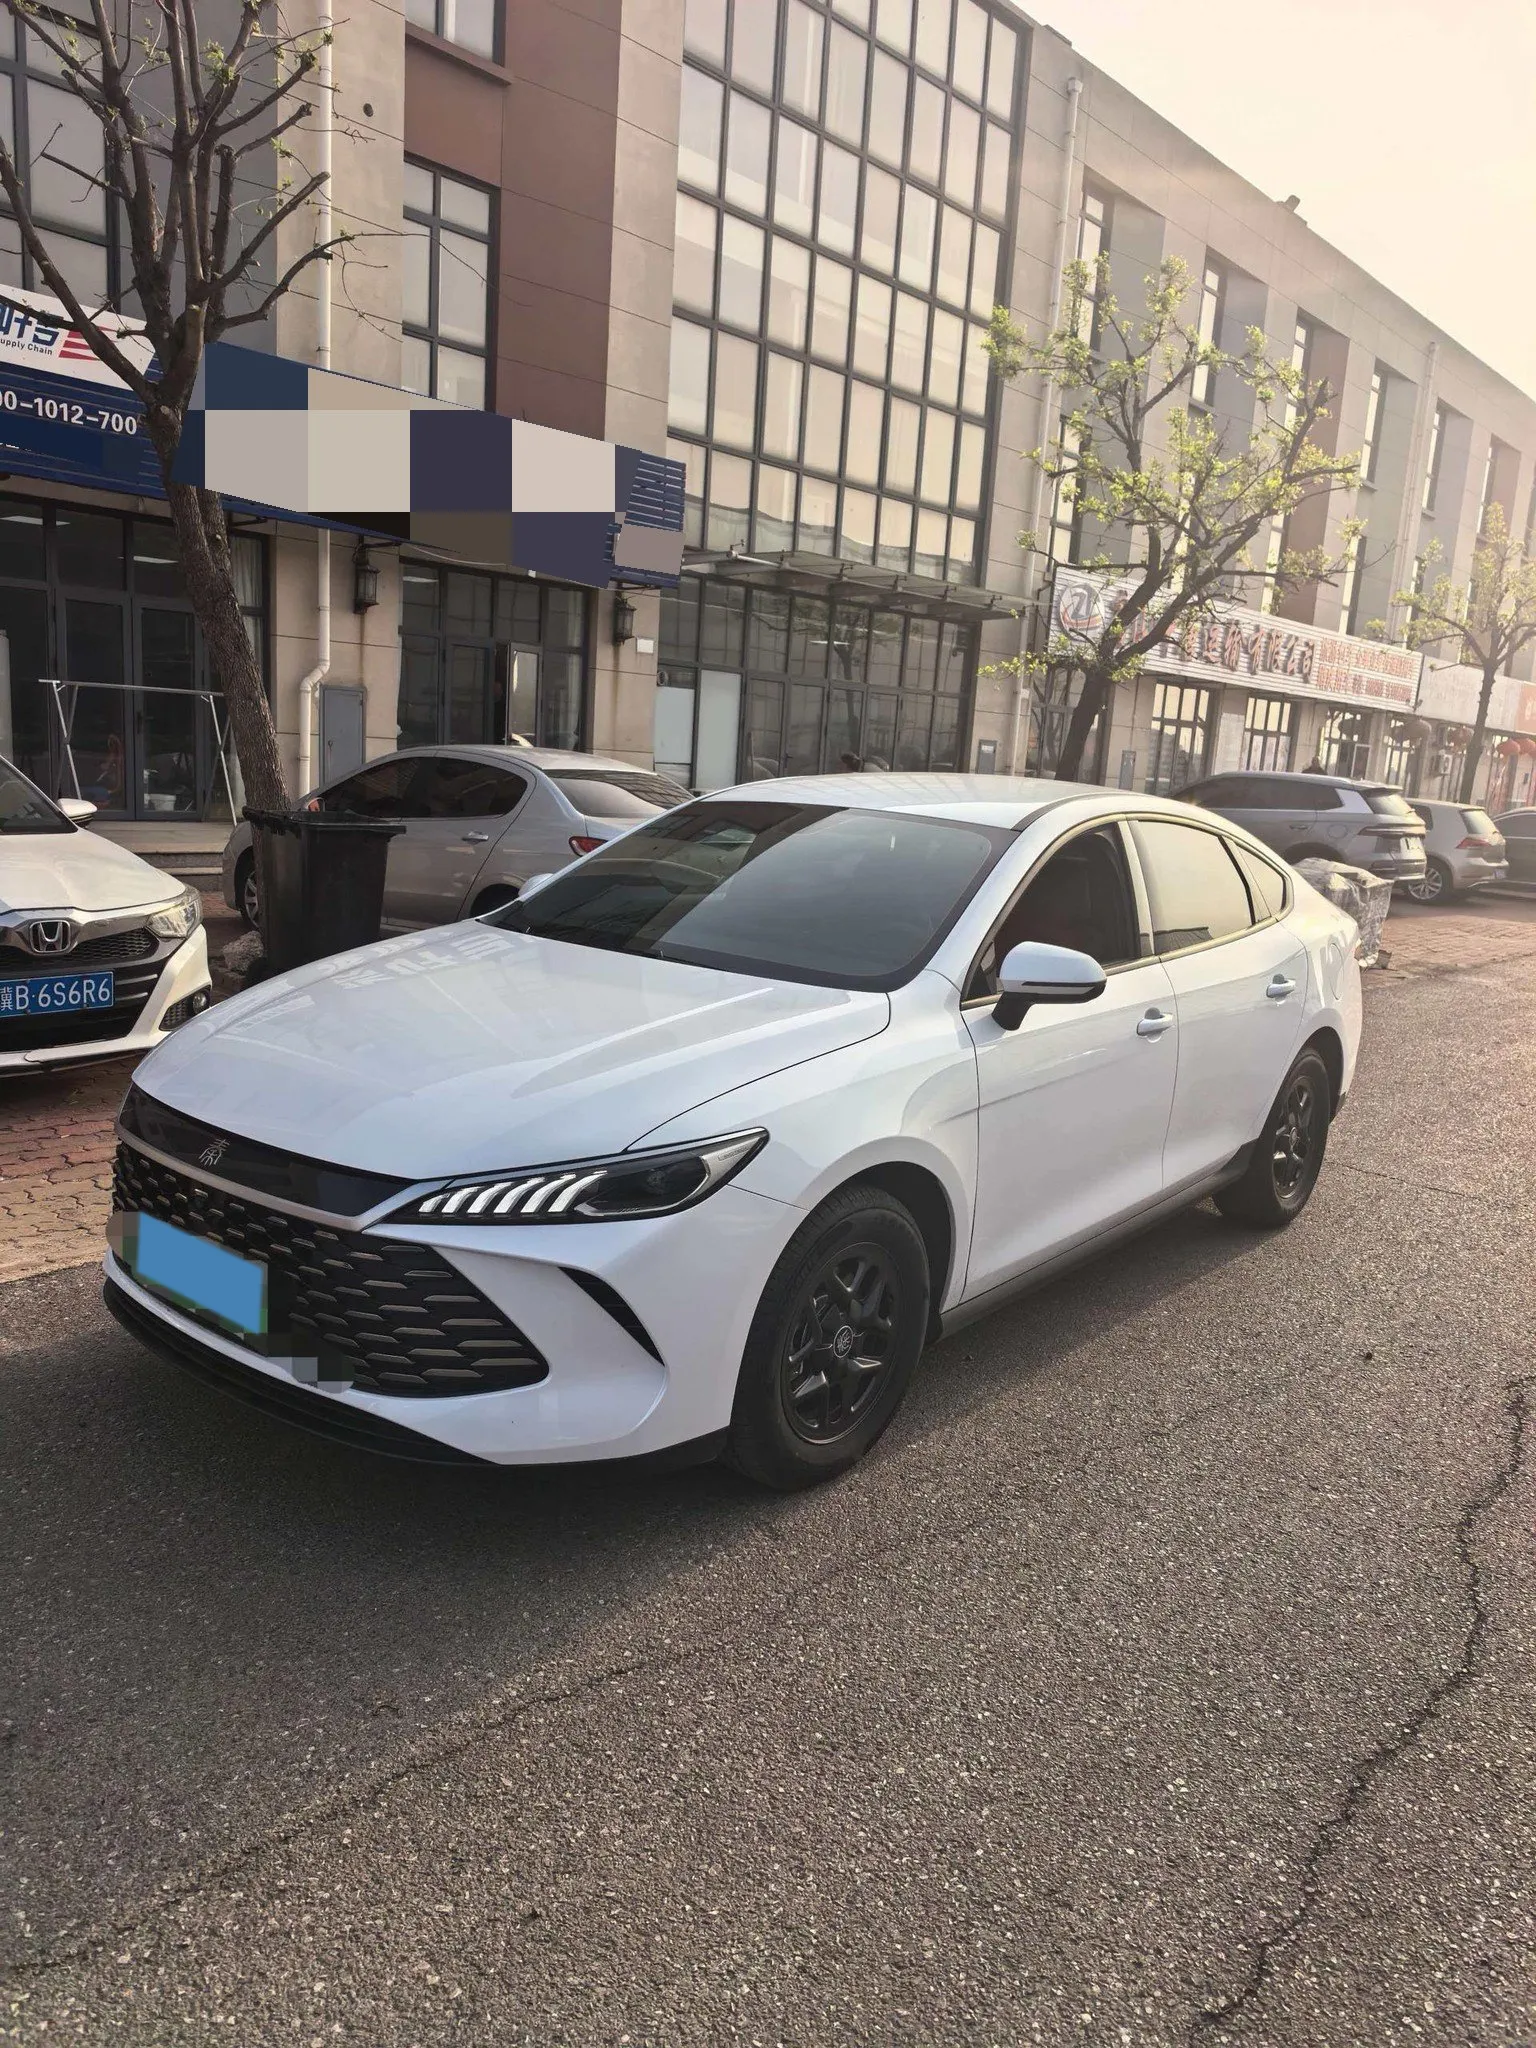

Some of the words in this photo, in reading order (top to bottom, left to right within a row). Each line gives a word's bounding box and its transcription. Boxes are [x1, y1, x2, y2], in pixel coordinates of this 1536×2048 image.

[0, 338, 26, 350] upply
[27, 343, 53, 356] Chain
[0, 389, 137, 435] 0-1012-700
